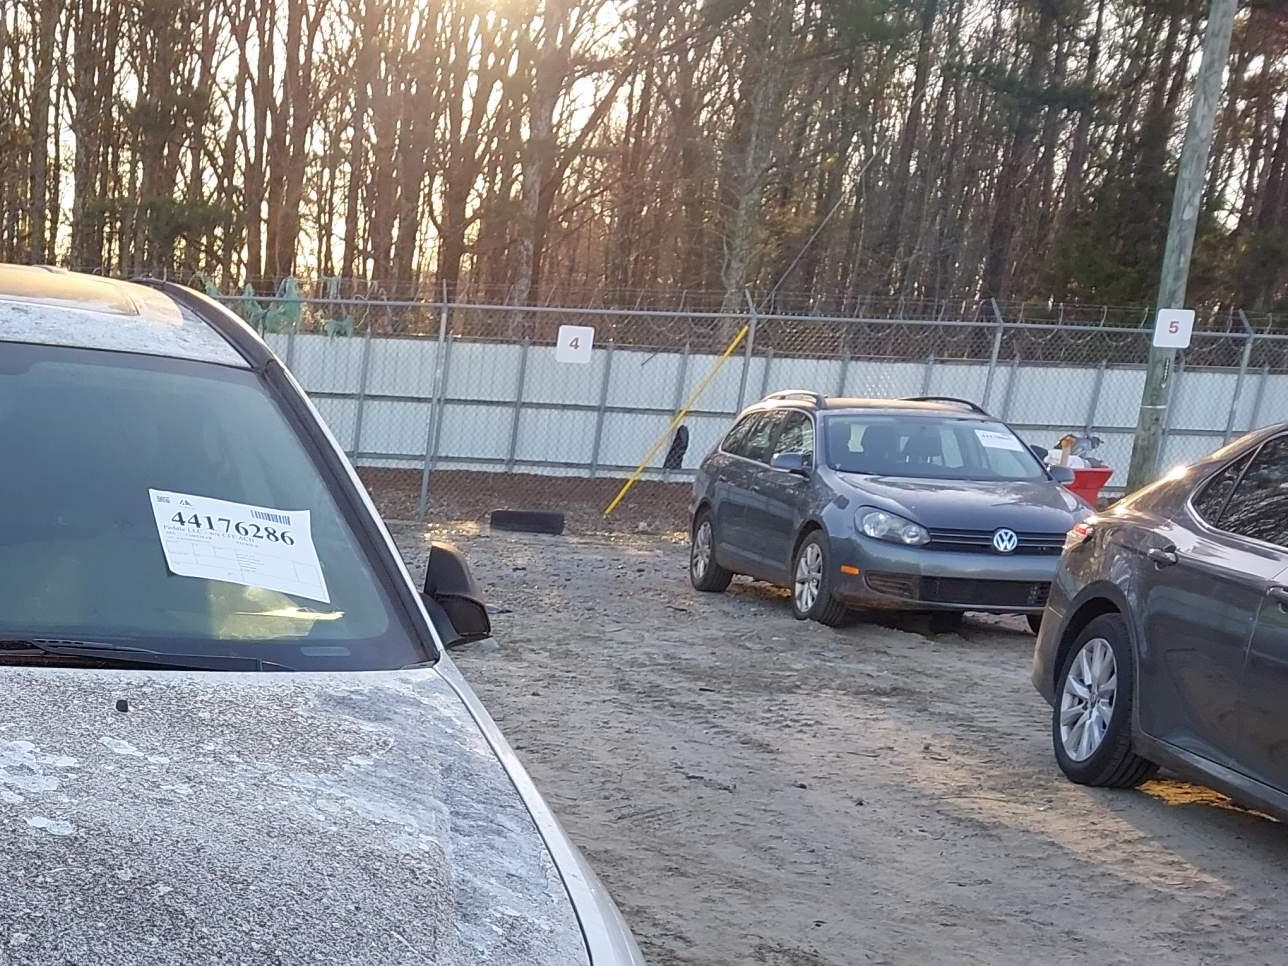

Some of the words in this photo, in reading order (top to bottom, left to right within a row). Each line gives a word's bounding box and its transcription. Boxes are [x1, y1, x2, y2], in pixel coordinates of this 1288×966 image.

[1168, 320, 1180, 334] 5
[569, 337, 580, 350] 4
[171, 511, 295, 546] 44176286
